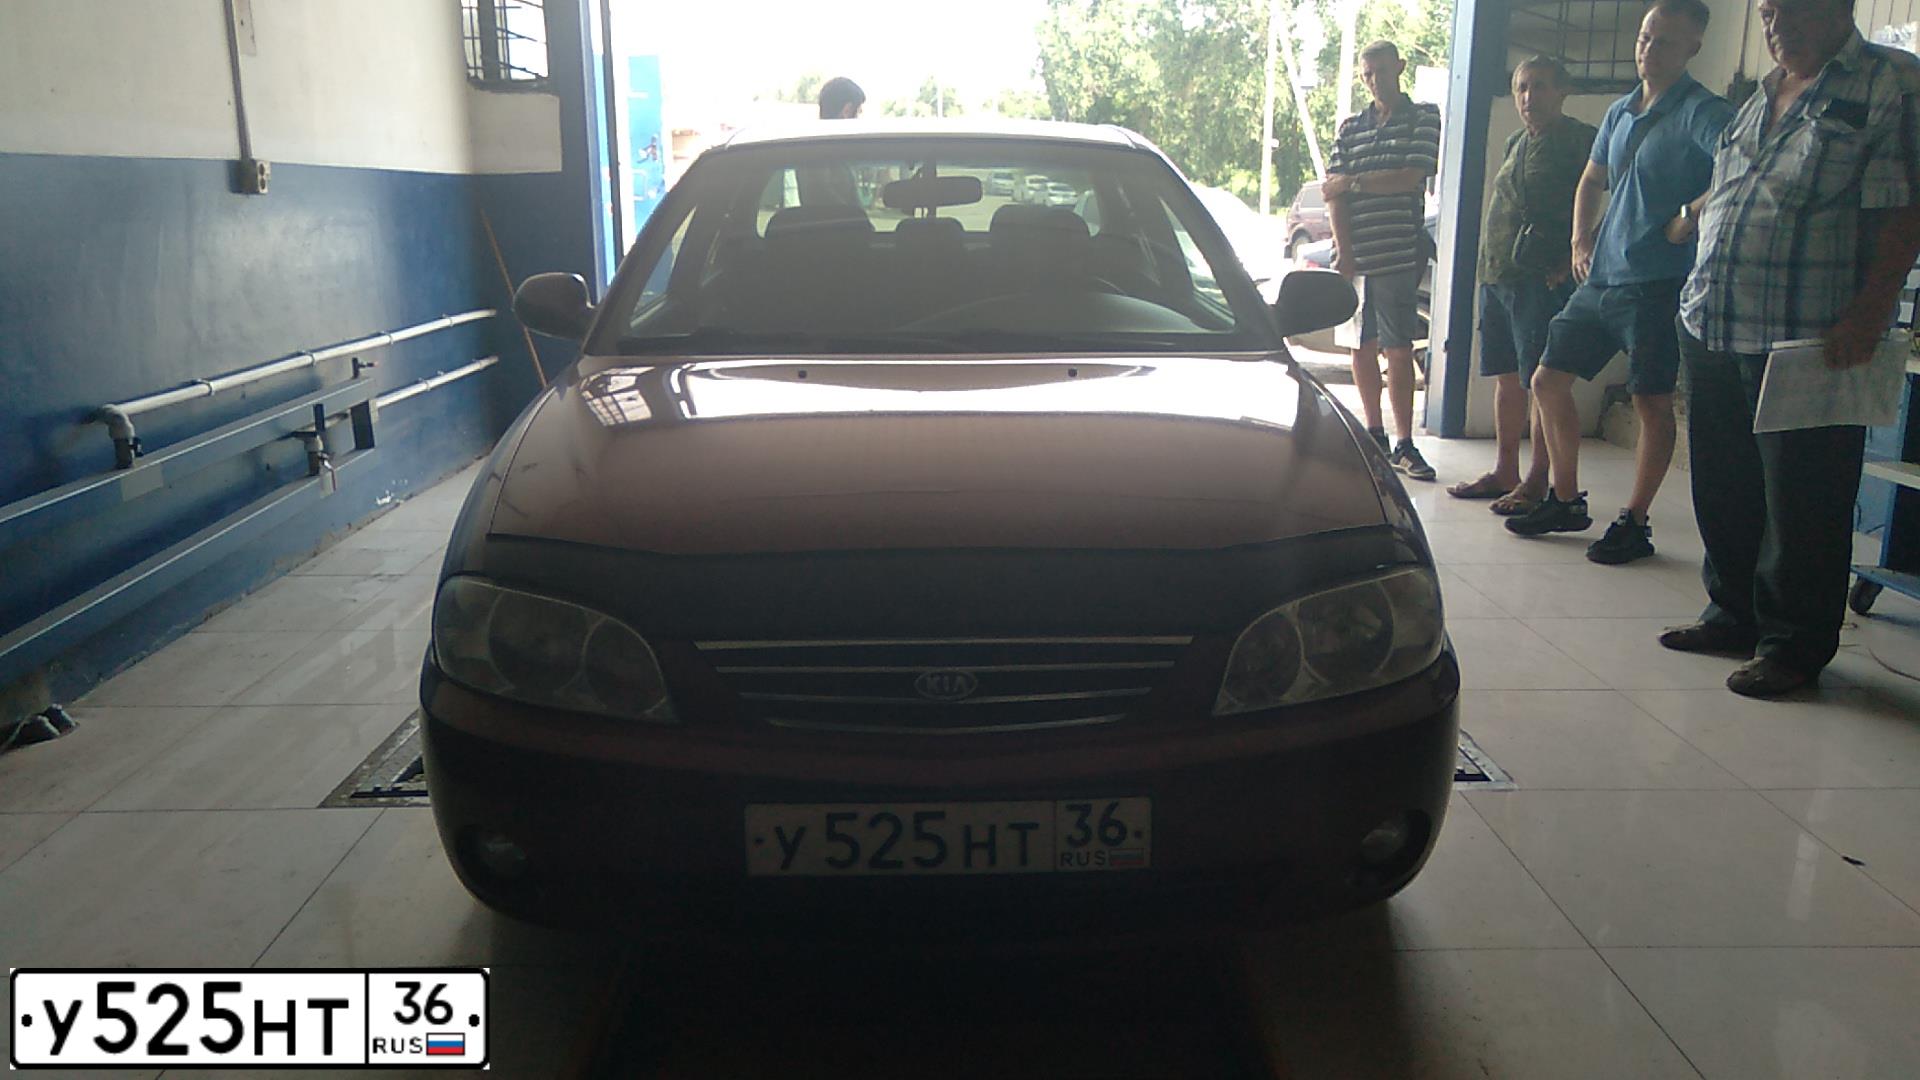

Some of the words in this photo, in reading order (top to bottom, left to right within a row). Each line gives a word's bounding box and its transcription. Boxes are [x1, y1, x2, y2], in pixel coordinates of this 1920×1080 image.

[924, 674, 970, 695] KIA
[1065, 801, 1128, 849] 36
[1059, 850, 1106, 867] RUS
